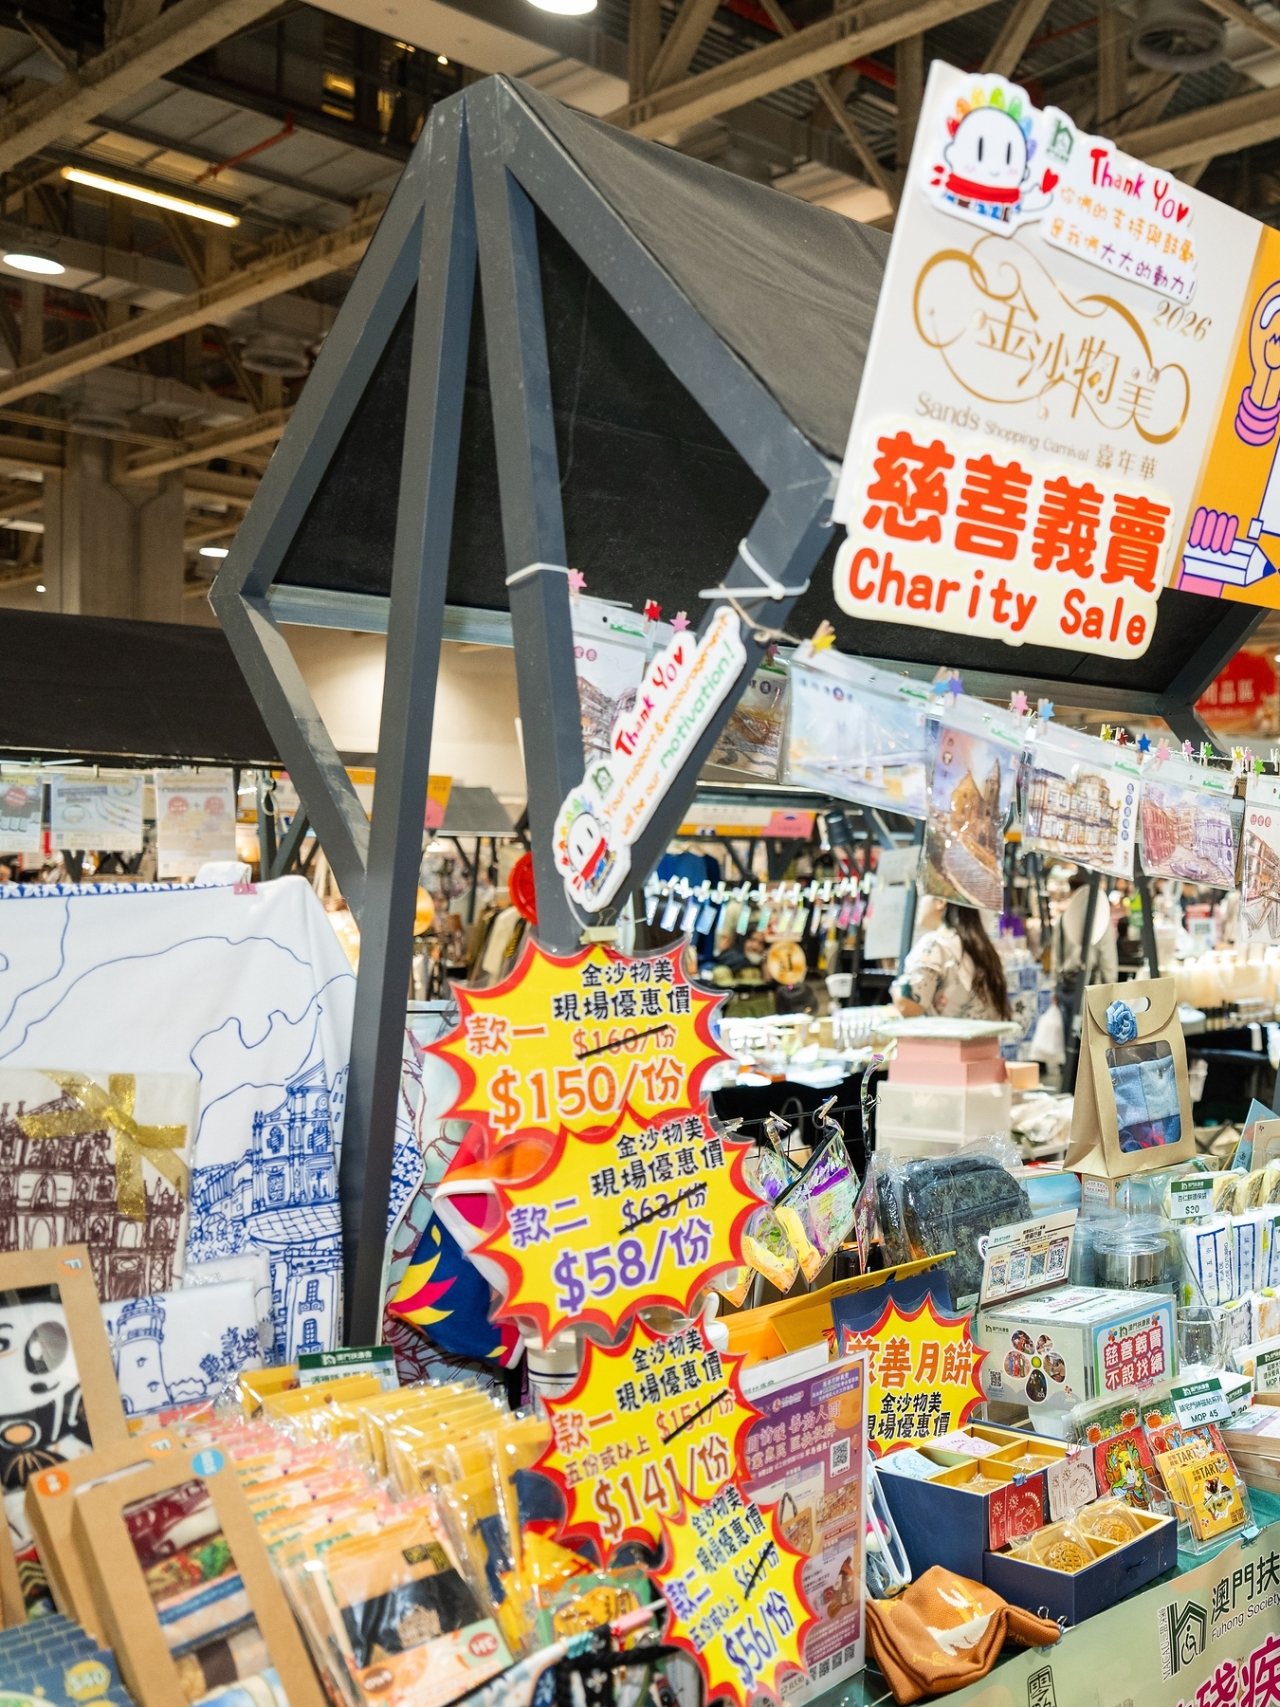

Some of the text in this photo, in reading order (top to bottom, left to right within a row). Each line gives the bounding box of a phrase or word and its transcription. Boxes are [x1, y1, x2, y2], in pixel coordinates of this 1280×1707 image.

[1090, 148, 1145, 200] Thank
[1150, 300, 1213, 343] 2026
[975, 298, 1155, 420] 金沙物美
[915, 391, 981, 431] Sands
[1043, 437, 1090, 462] Carnival
[1096, 443, 1159, 481] 嘉年華
[862, 431, 1171, 592] 慈善義賣
[848, 547, 1147, 646] Charity Sale
[615, 694, 655, 756] Thank
[622, 640, 736, 836] will be our motivation!
[603, 787, 625, 819] Your
[625, 735, 657, 787] support
[582, 958, 674, 988] 金沙物美
[553, 984, 692, 1023] 現場優惠價
[466, 1014, 548, 1057] 款一
[489, 1056, 686, 1134] $150/份
[616, 1115, 705, 1160] 金沙物美
[591, 1138, 726, 1199] 現場優惠價
[508, 1196, 590, 1250] 款二
[553, 1215, 713, 1317] $58/份
[630, 1328, 703, 1374] 金沙物美
[1104, 1326, 1163, 1369] 慈善義賣
[1106, 1350, 1165, 1391] 不設找續
[615, 1350, 724, 1413] 現場優惠價
[880, 1391, 942, 1415] 金沙物美
[1266, 1378, 1278, 1386] MOP
[554, 1411, 617, 1455] 款一
[1191, 1409, 1219, 1423] MOP 45
[564, 1434, 651, 1489] 五份或以上
[594, 1435, 730, 1544] $141/份
[691, 1484, 743, 1538] 金沙物美
[696, 1502, 766, 1575] 現場優惠價
[664, 1569, 712, 1621] 款二
[689, 1596, 740, 1654] 五份或以上
[724, 1591, 795, 1693] $56/份
[1211, 1613, 1244, 1642] Fuhong
[1161, 1641, 1171, 1681] MACAU
